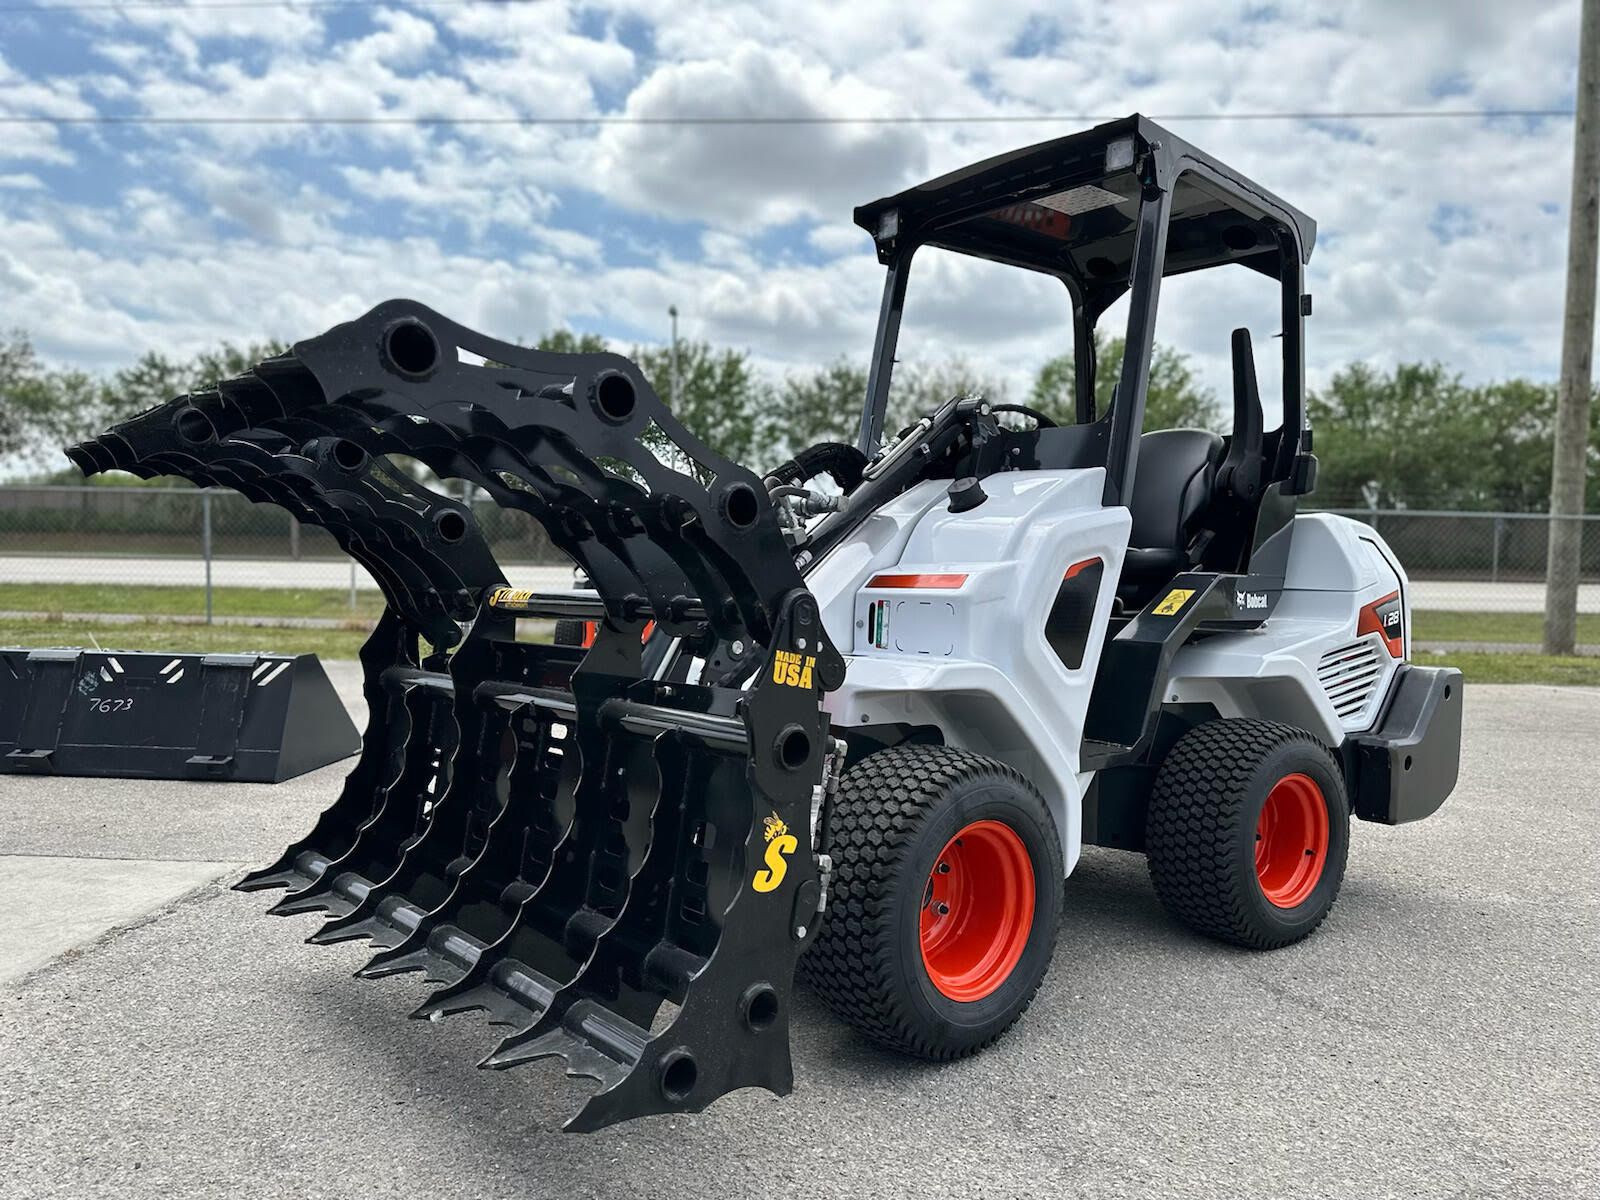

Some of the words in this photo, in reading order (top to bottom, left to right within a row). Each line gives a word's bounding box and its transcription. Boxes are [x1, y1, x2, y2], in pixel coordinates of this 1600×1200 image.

[775, 650, 802, 665] MADE
[805, 655, 816, 668] IN
[773, 661, 812, 689] USA
[90, 697, 134, 713] 7673
[752, 834, 798, 893] S
